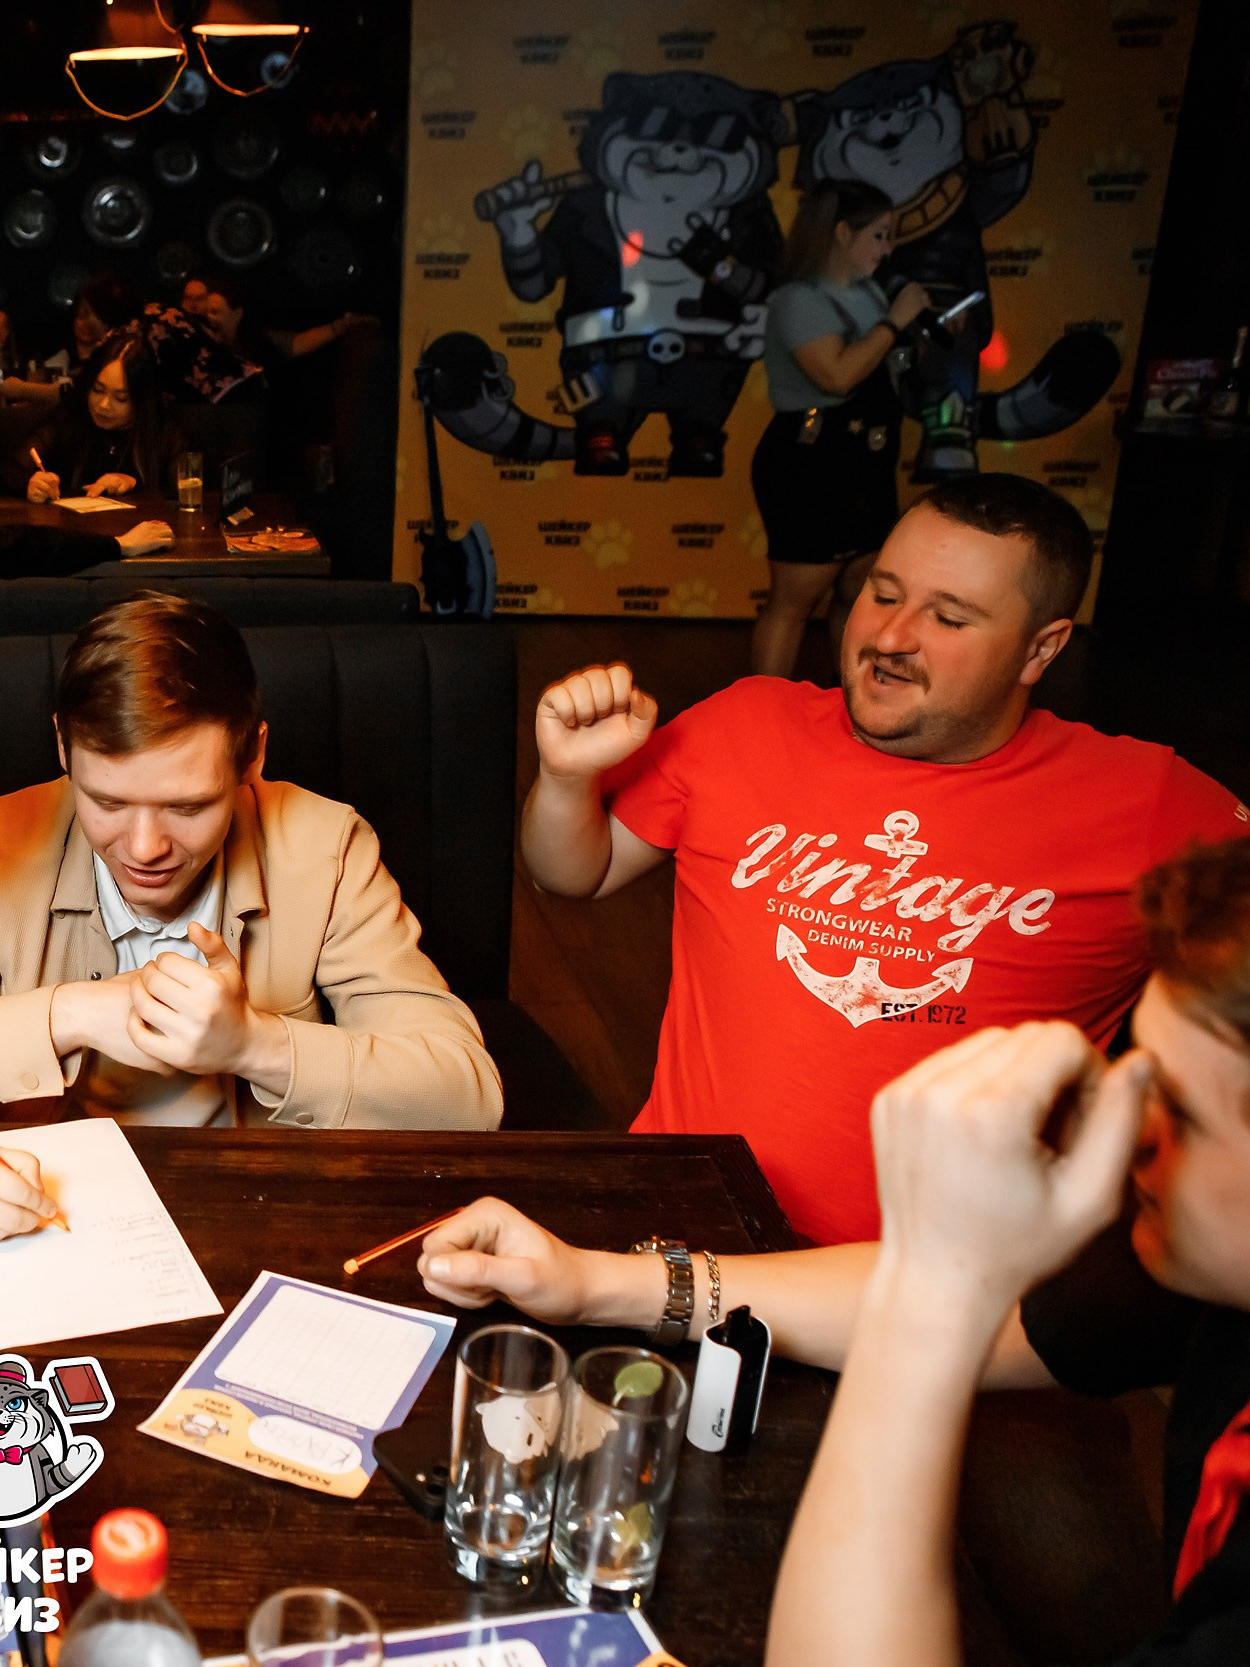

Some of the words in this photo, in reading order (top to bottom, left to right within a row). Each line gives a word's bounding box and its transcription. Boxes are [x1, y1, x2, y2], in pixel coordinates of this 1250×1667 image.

[731, 823, 1056, 953] Vintage
[766, 897, 913, 942] STRONGWEAR
[807, 928, 865, 952] DENIM
[868, 941, 936, 963] SUPPLY
[927, 1004, 966, 1025] 1972
